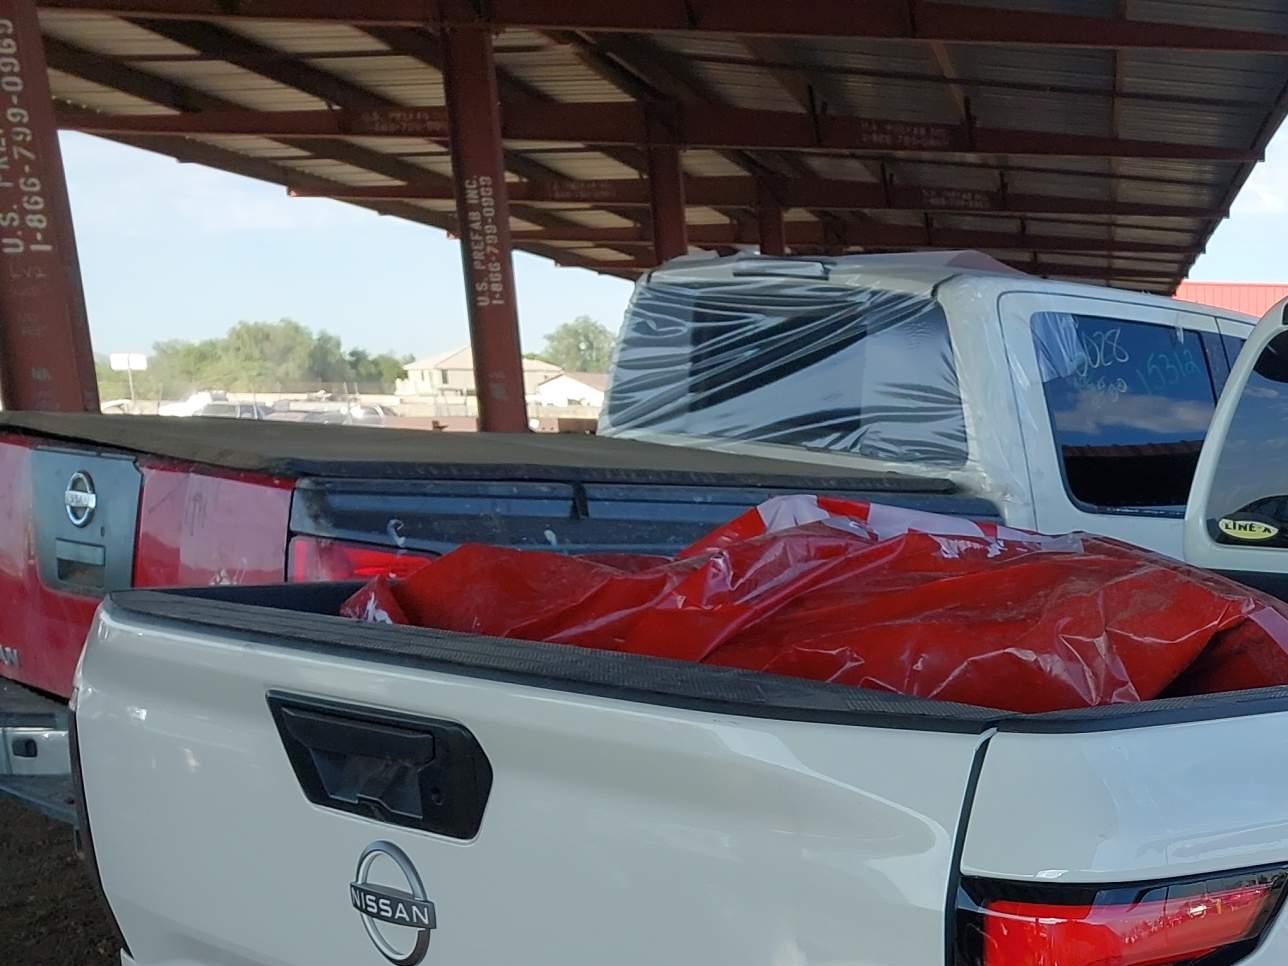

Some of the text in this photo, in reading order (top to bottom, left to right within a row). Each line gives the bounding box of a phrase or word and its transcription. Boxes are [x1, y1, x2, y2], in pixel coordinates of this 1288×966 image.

[465, 175, 479, 204] INC.
[468, 210, 486, 270] PREFAB
[480, 176, 505, 305] 1-866-799-0969
[351, 887, 429, 924] NISSAN
